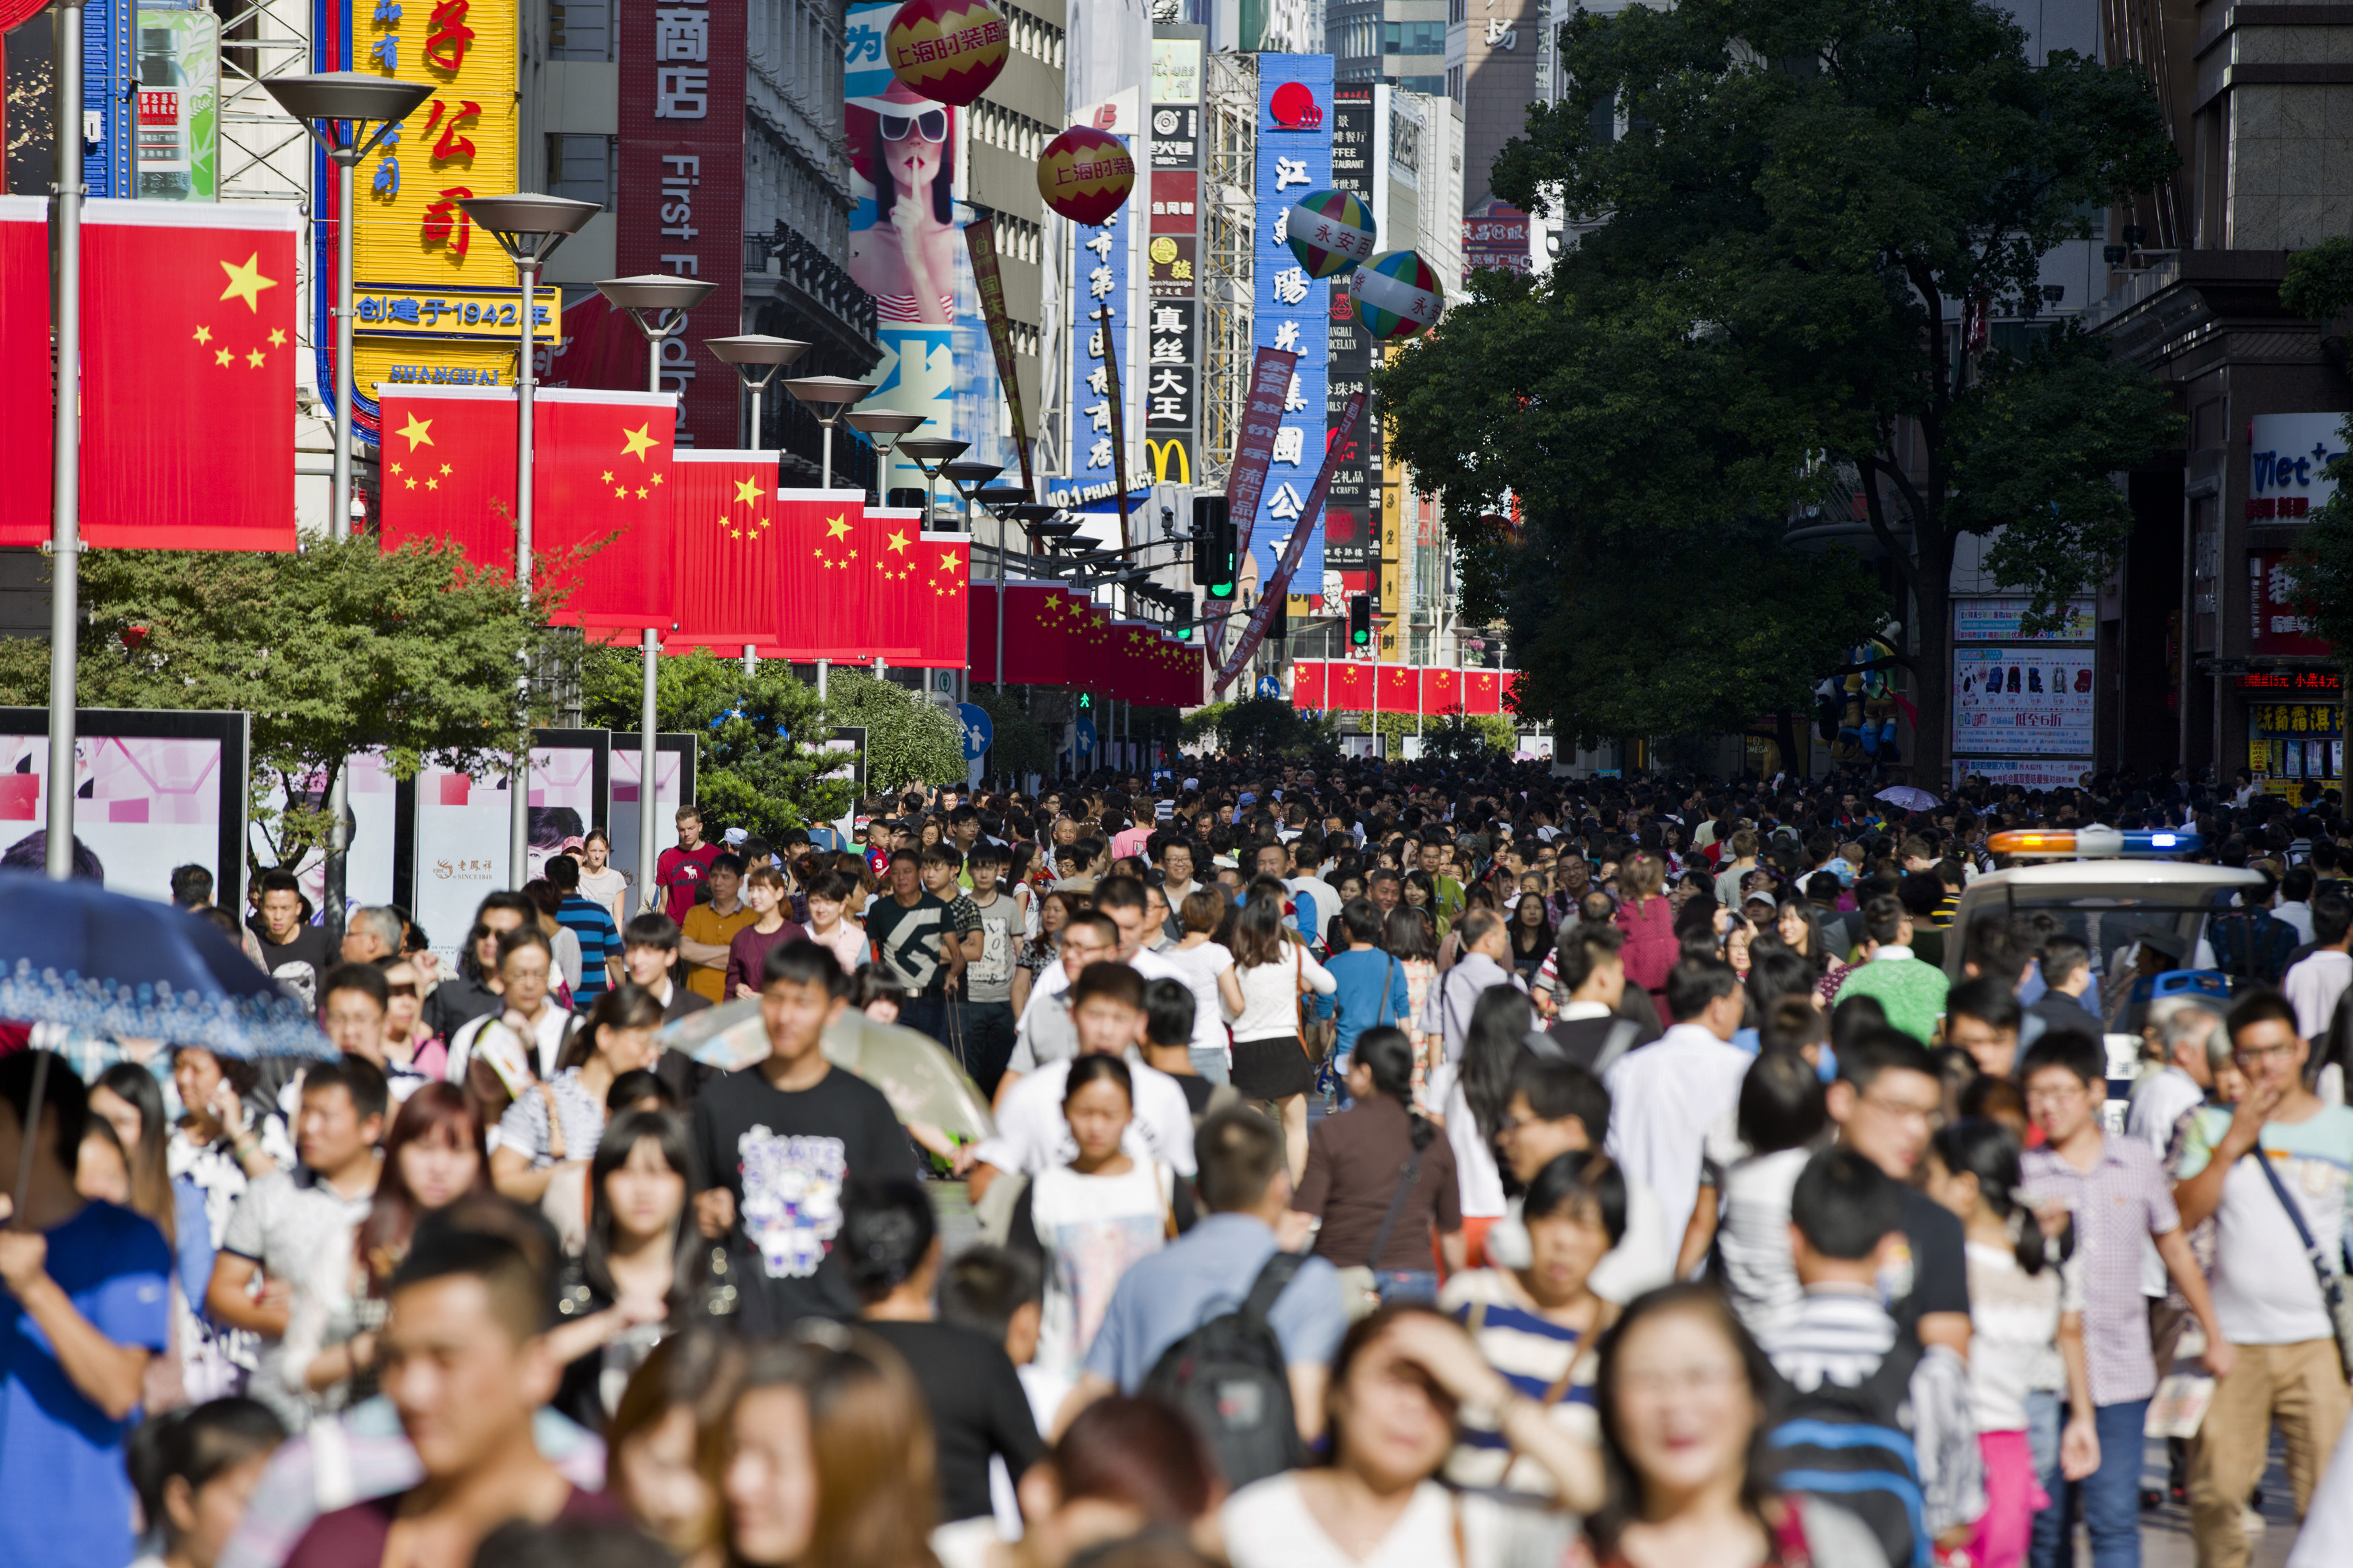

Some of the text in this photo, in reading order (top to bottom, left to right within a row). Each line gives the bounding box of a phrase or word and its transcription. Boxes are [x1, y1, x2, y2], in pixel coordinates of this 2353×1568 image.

[654, 0, 709, 119] 商店
[372, 0, 403, 194] 品有公司
[138, 105, 179, 115] 川贝枇杷
[661, 155, 700, 241] First
[1152, 201, 1194, 215] 鱼网咖
[1315, 224, 1372, 256] 永安百
[1148, 306, 1188, 422] 真丝大王
[391, 365, 499, 384] SHANGHAI
[2253, 450, 2311, 493] Viet
[1083, 470, 1154, 502] PHARACY
[1336, 487, 1359, 495] CRAFTS
[1386, 493, 1394, 509] 3
[1387, 530, 1394, 544] 2
[1344, 589, 1366, 597] KFC
[2295, 673, 2340, 688] 小菜4元
[2016, 712, 2062, 727] 低至6折
[1153, 771, 1172, 780] 快照
[875, 859, 883, 869] 3
